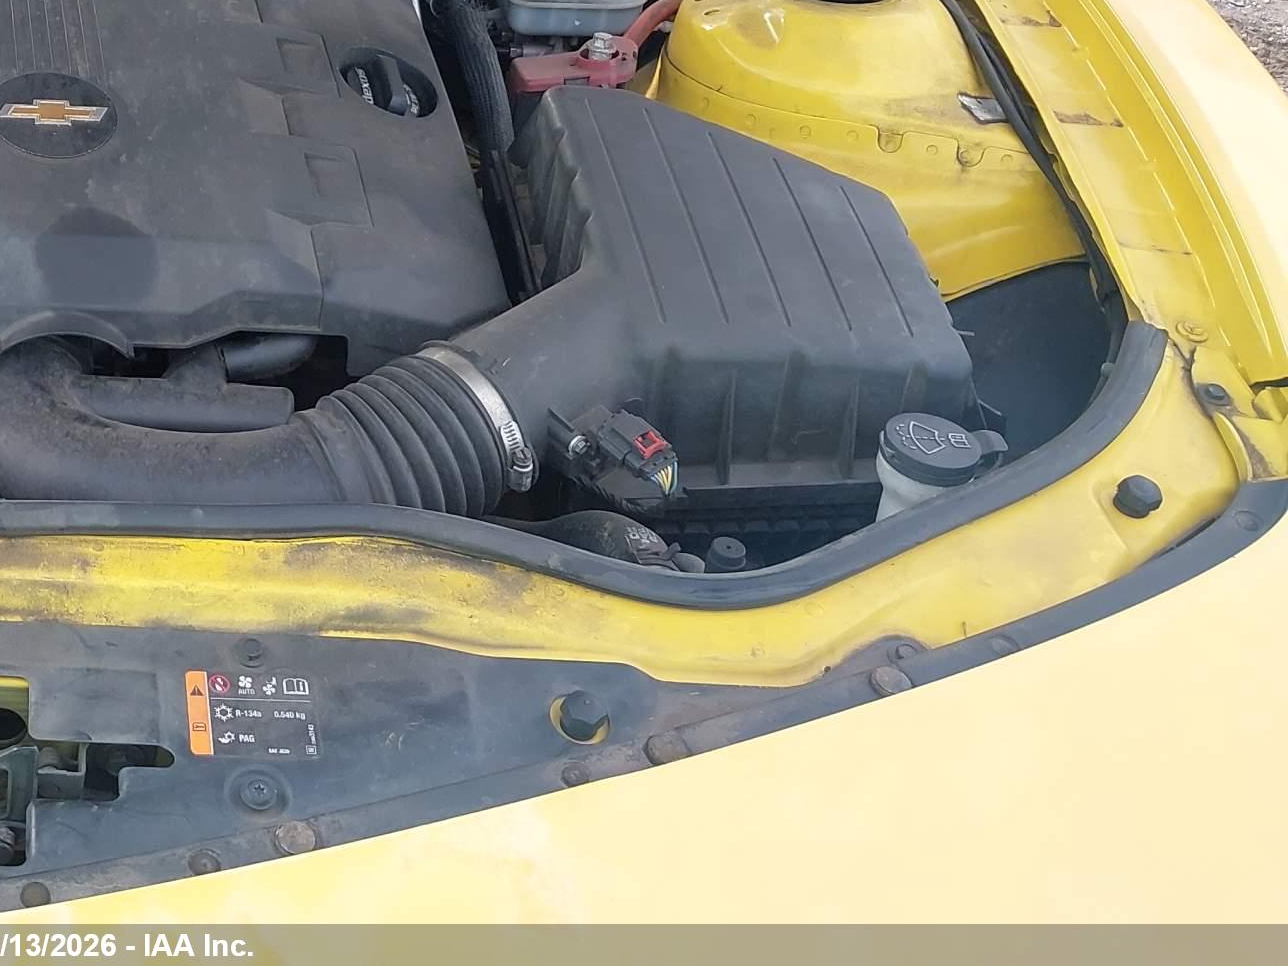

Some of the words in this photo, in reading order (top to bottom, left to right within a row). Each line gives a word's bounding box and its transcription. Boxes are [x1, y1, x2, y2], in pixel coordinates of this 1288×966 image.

[354, 67, 375, 105] dexos
[235, 709, 262, 718] R-134a
[238, 733, 255, 743] PAG
